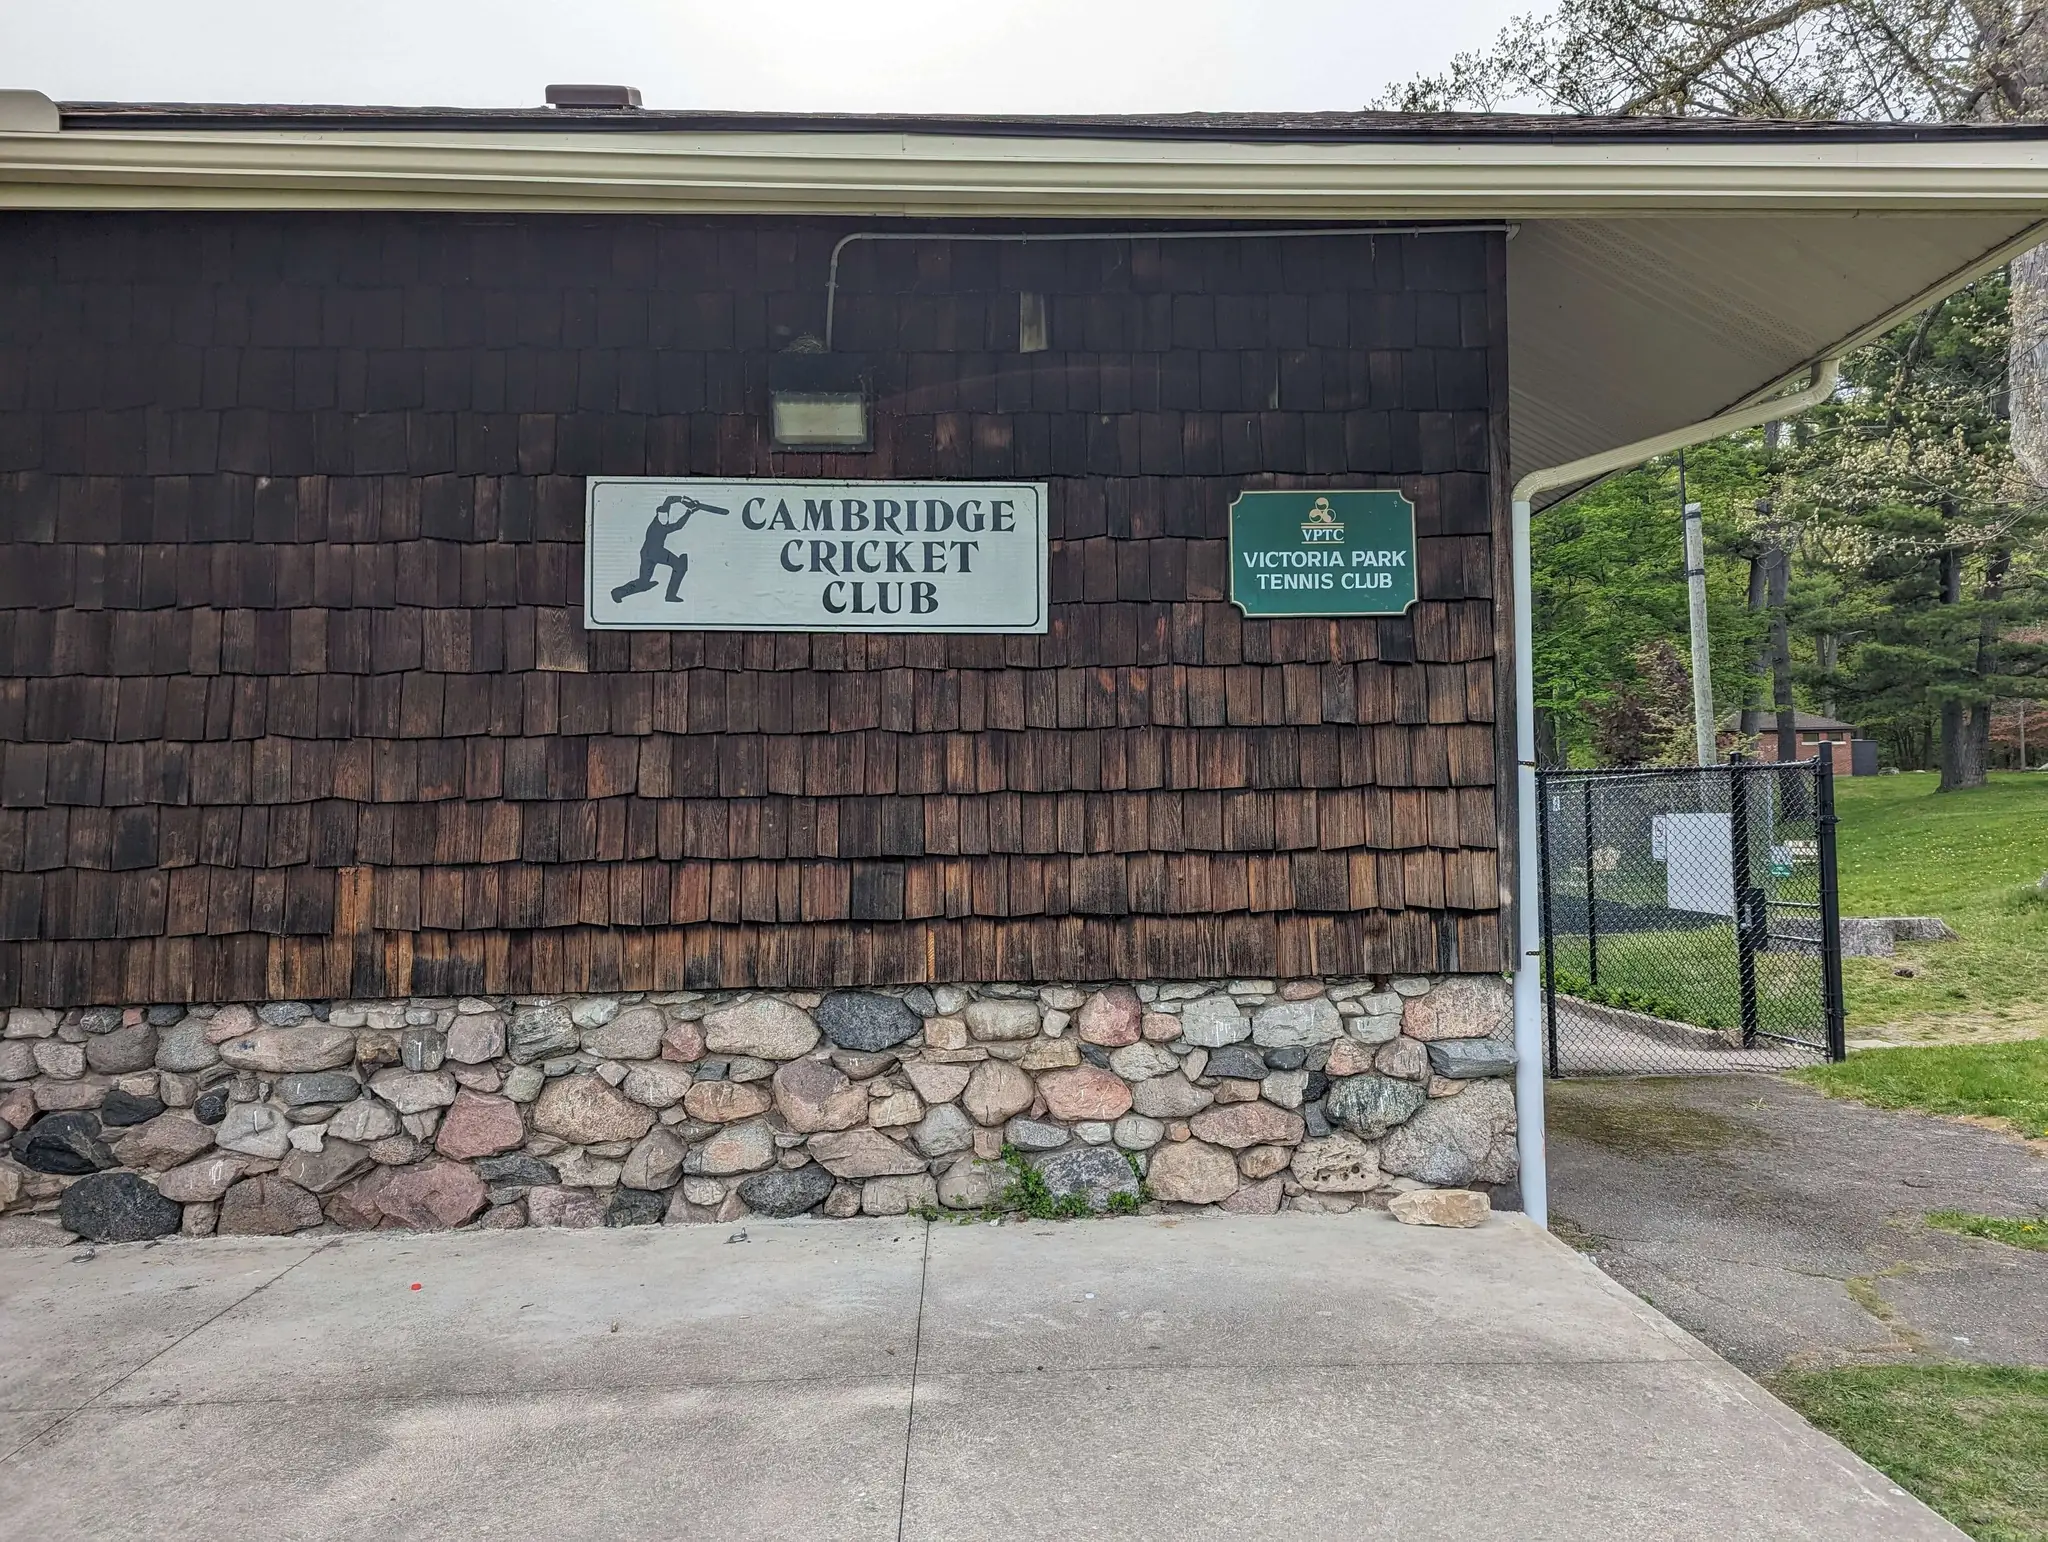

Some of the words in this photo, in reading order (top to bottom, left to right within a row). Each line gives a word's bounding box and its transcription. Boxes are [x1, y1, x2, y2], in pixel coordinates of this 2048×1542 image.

[741, 497, 1016, 535] CAMBRIDGE
[1302, 529, 1344, 541] VPTC
[780, 539, 979, 576] CRICKET
[1243, 551, 1345, 568] VICTORIA
[1352, 550, 1407, 567] PARK
[1256, 573, 1334, 590] TENNIS
[1341, 572, 1393, 589] CLUB
[822, 580, 939, 614] CLUB
